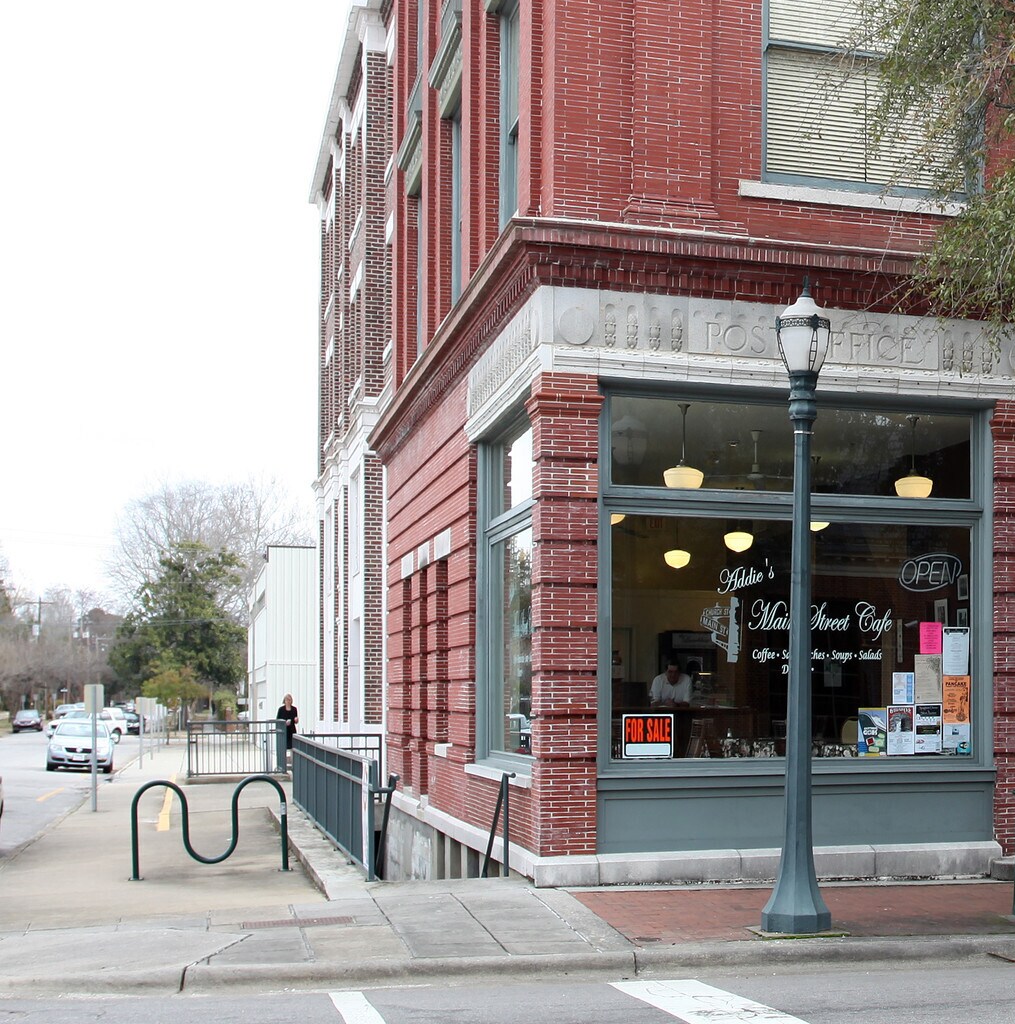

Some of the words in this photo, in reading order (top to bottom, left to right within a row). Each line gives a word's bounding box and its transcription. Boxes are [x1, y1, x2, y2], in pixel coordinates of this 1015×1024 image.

[706, 320, 777, 355] POS
[830, 328, 925, 365] FFICE
[717, 558, 774, 594] Addie's
[902, 561, 957, 585] OPEN
[703, 617, 718, 630] MAIN
[749, 599, 790, 630] Mai
[855, 601, 893, 641] Cafe
[752, 648, 775, 663] Coffee
[782, 649, 825, 660] Saches
[831, 649, 853, 663] Soups
[859, 648, 883, 661] Salads
[625, 718, 644, 742] FOR
[647, 717, 671, 742] SALE
